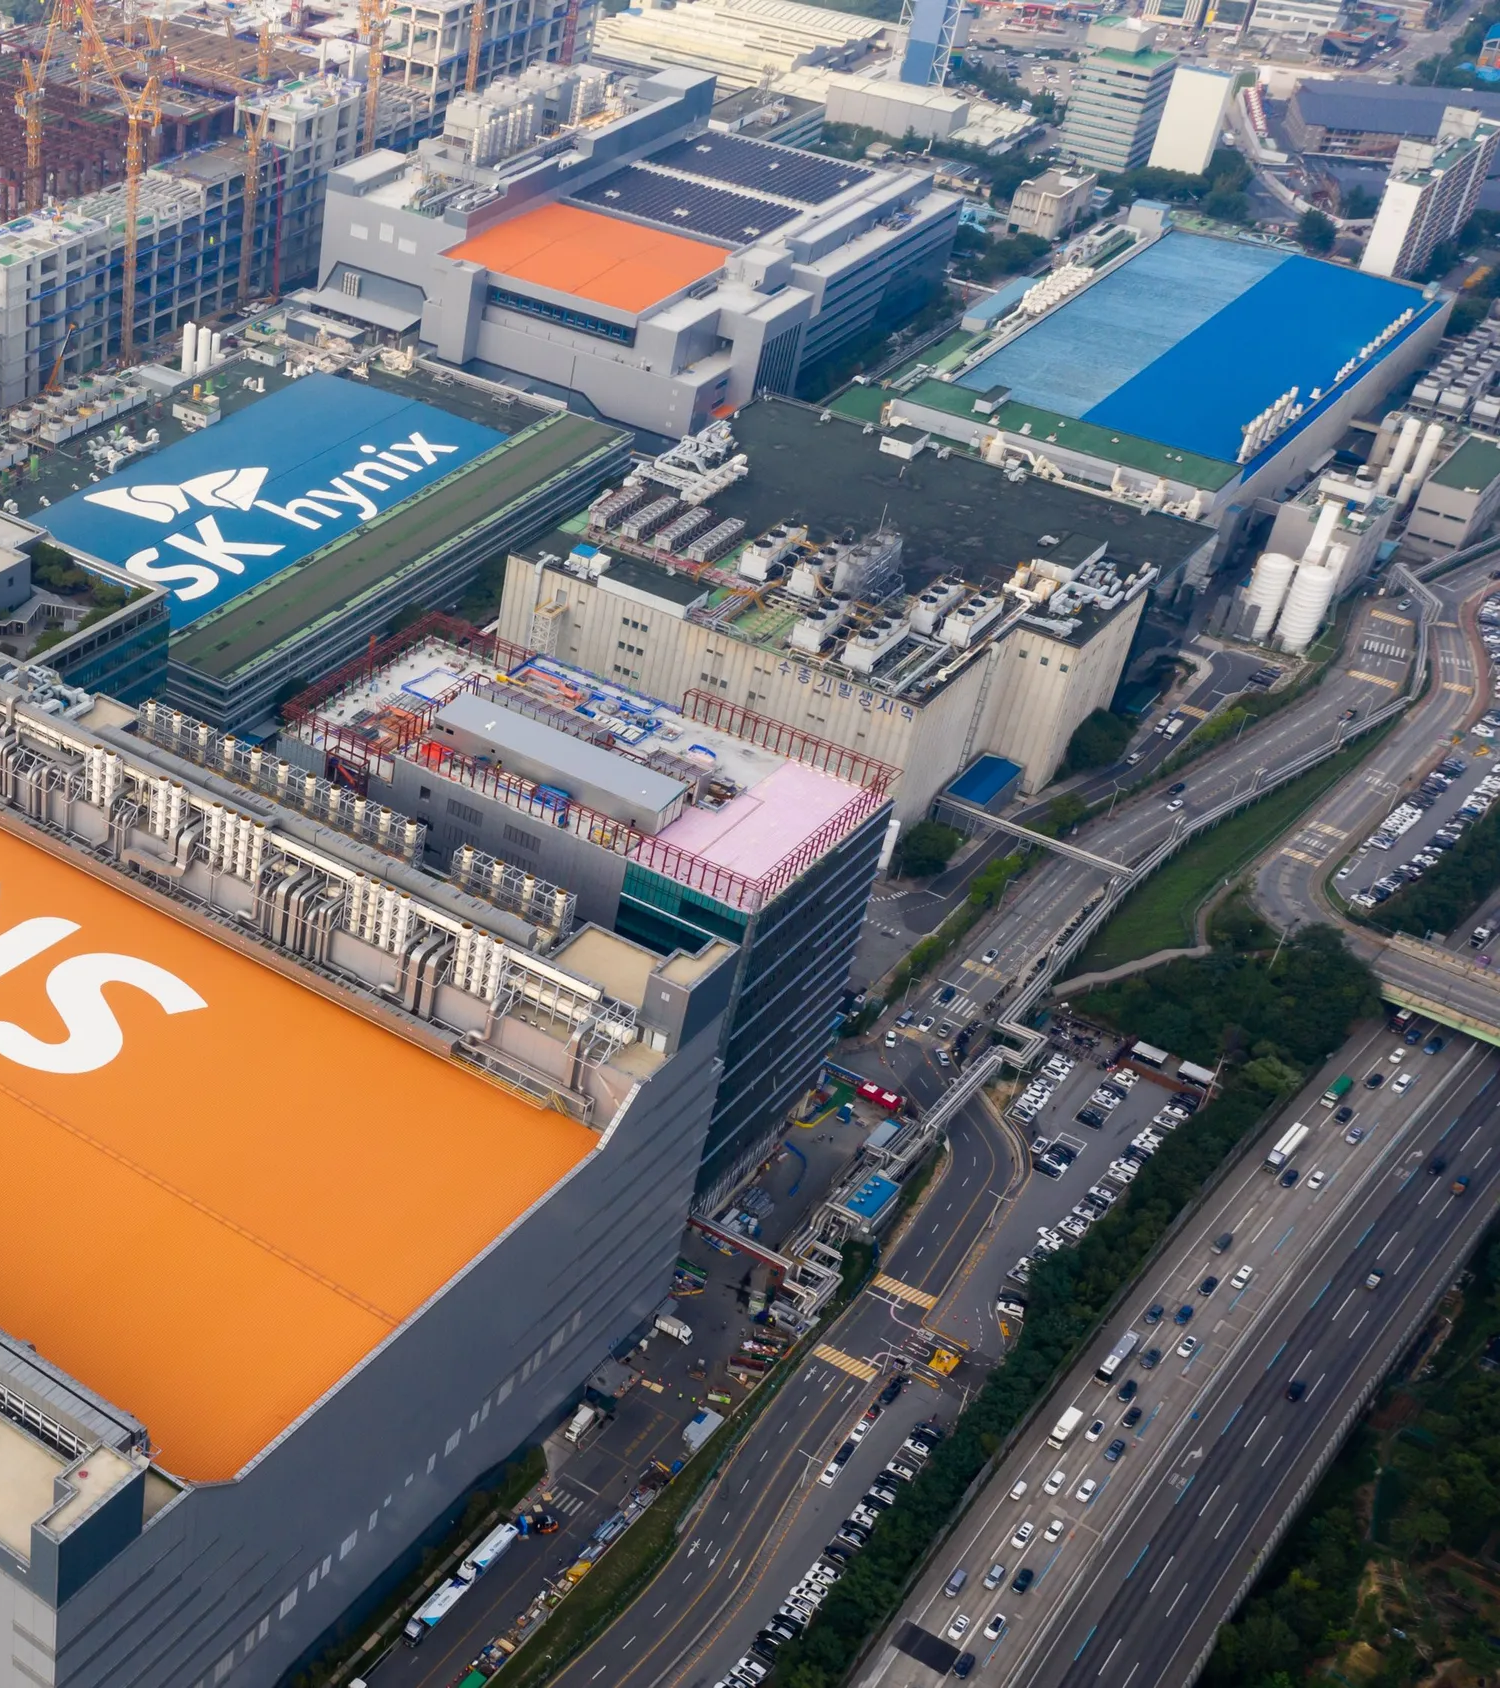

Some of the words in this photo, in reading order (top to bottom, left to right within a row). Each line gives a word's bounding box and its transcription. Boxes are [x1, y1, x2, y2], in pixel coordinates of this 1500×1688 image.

[125, 515, 286, 601] SK
[253, 432, 459, 530] hynix
[778, 661, 914, 723] 수증기발생지역
